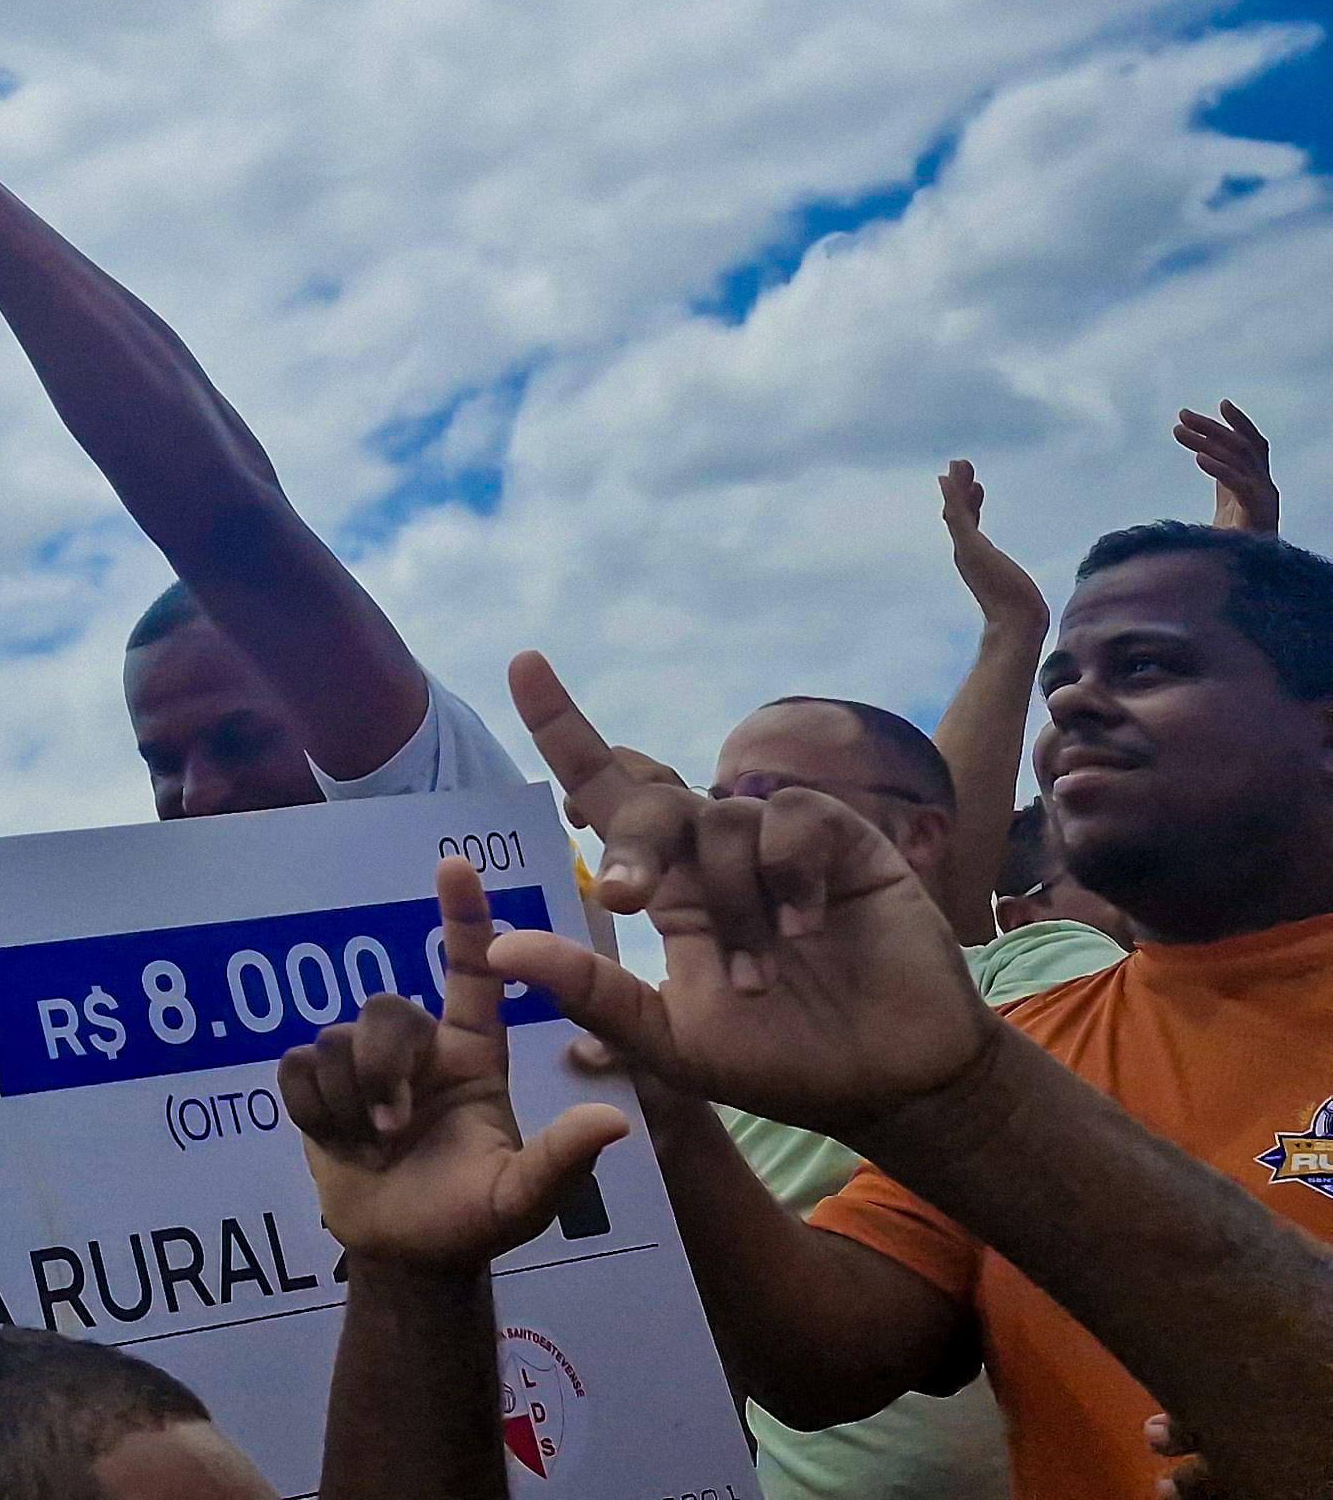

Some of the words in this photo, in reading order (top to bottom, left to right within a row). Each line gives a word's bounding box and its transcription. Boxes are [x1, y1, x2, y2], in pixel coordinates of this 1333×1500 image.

[36, 984, 128, 1061] R$
[164, 1086, 280, 1151] (OITO
[29, 1211, 319, 1333] RURAL
